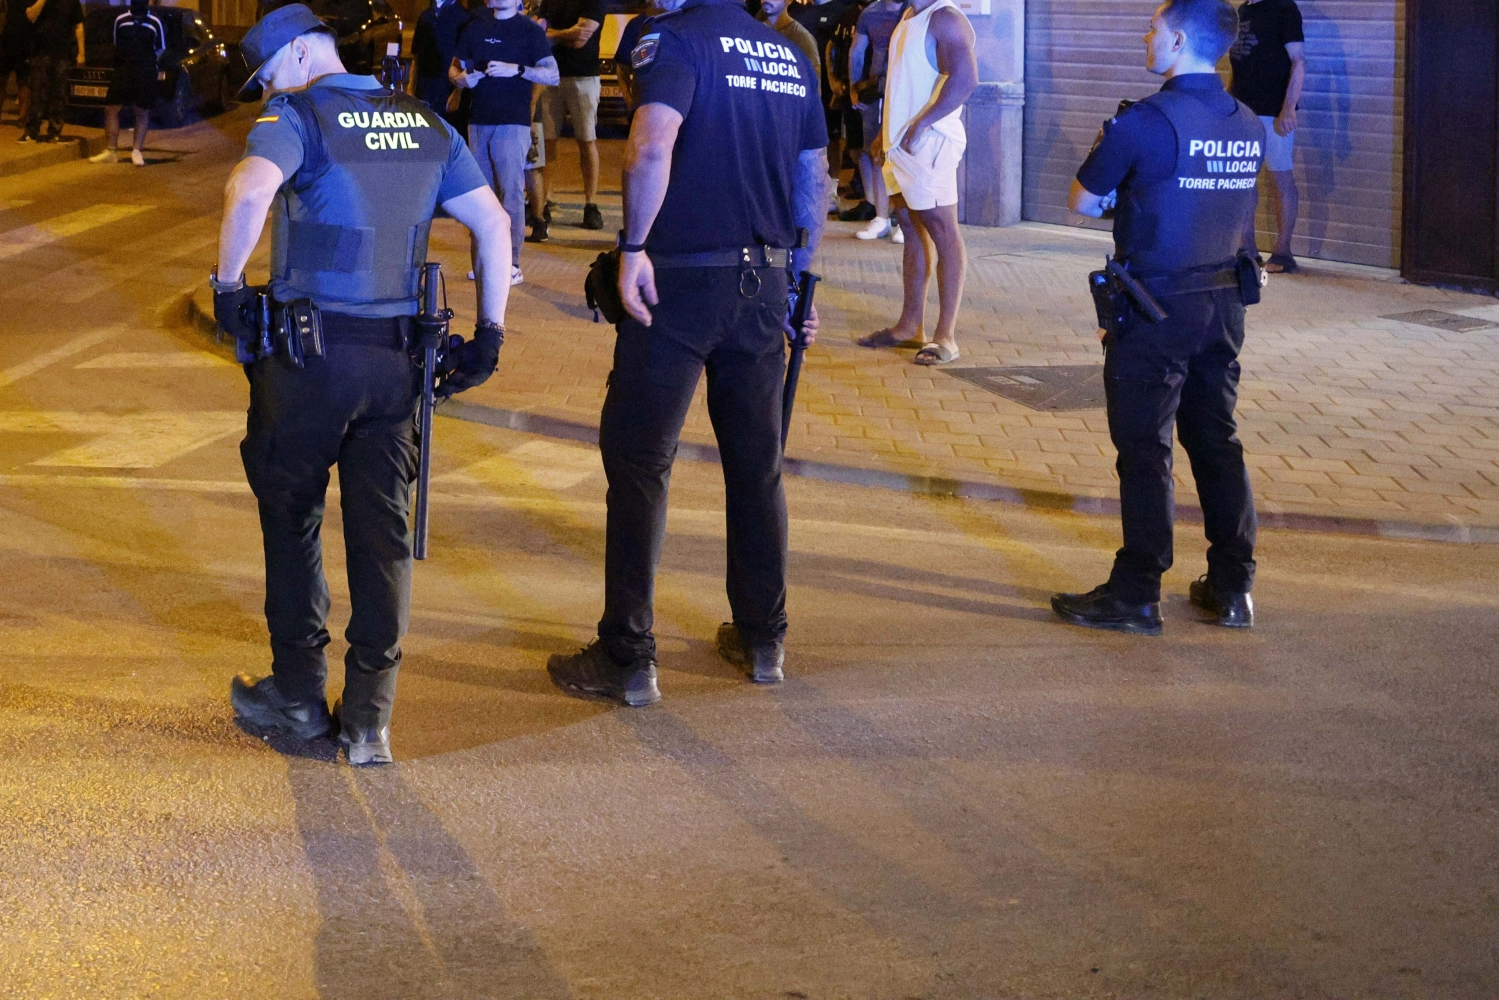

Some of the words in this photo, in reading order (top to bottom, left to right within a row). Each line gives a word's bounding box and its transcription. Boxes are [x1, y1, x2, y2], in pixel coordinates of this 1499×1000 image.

[719, 36, 797, 63] POLICIA
[762, 61, 801, 79] LOCAL
[761, 78, 806, 98] PACHECO
[338, 111, 430, 129] GUARDIA
[365, 131, 420, 150] CIVIL
[1189, 139, 1261, 157] POLICIA
[1226, 161, 1257, 173] LOCAL
[1178, 177, 1216, 189] TORRE
[1217, 177, 1256, 190] PACHECO
